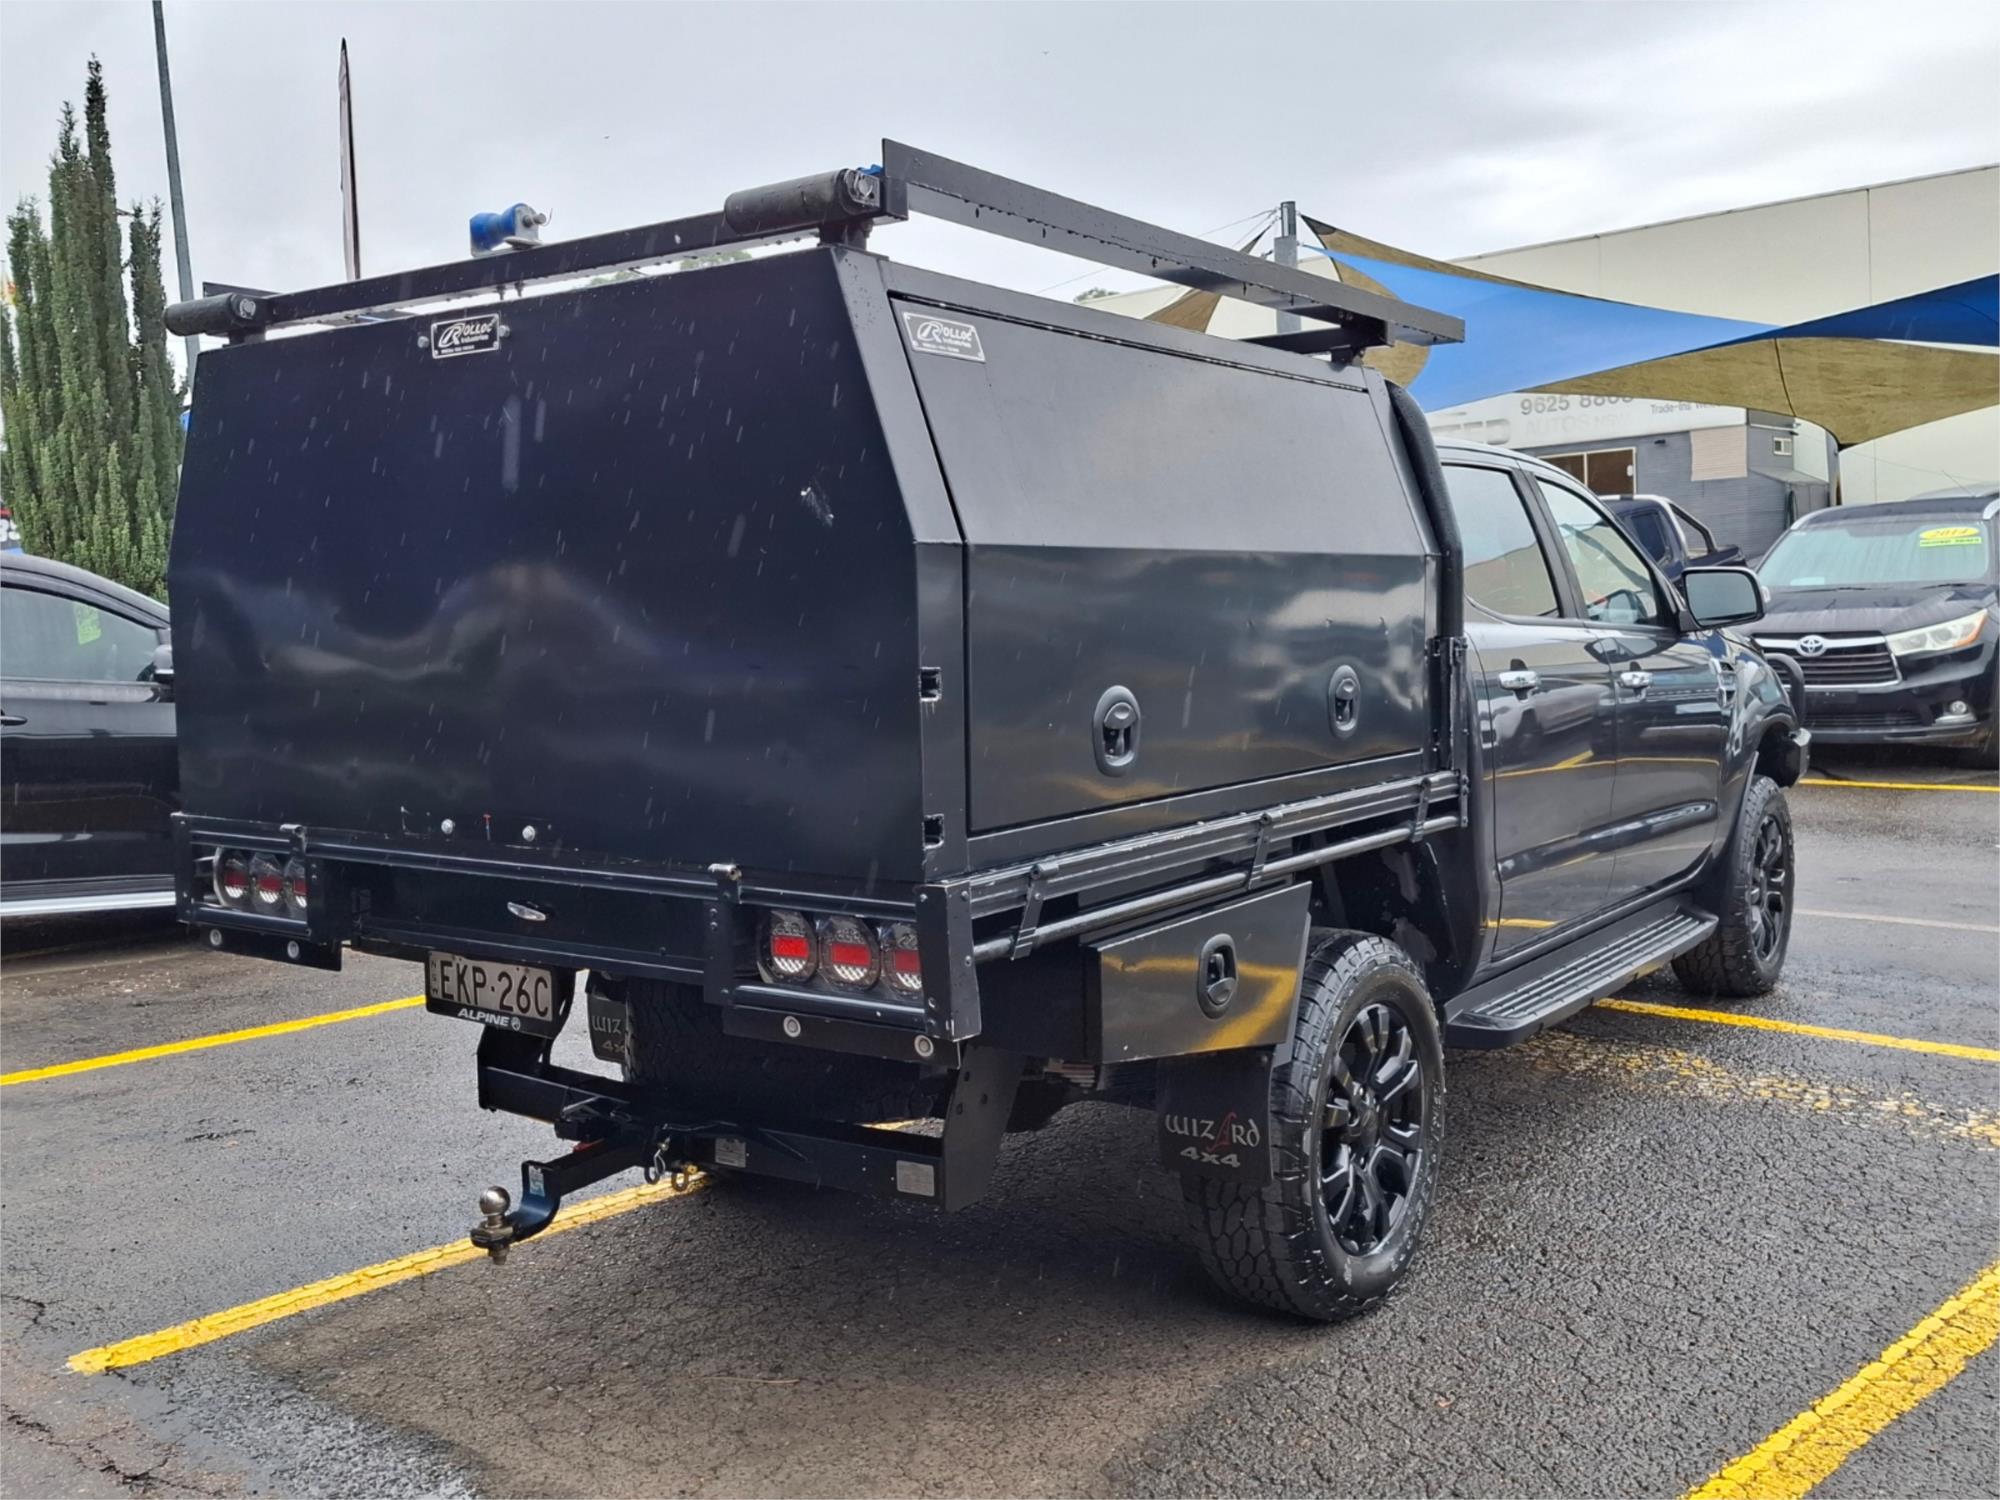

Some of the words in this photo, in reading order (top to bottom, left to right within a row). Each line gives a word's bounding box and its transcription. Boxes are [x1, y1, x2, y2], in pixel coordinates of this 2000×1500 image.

[1520, 396, 1570, 415] 9625
[457, 1008, 510, 1028] ALPINE
[591, 1015, 621, 1033] WIZ
